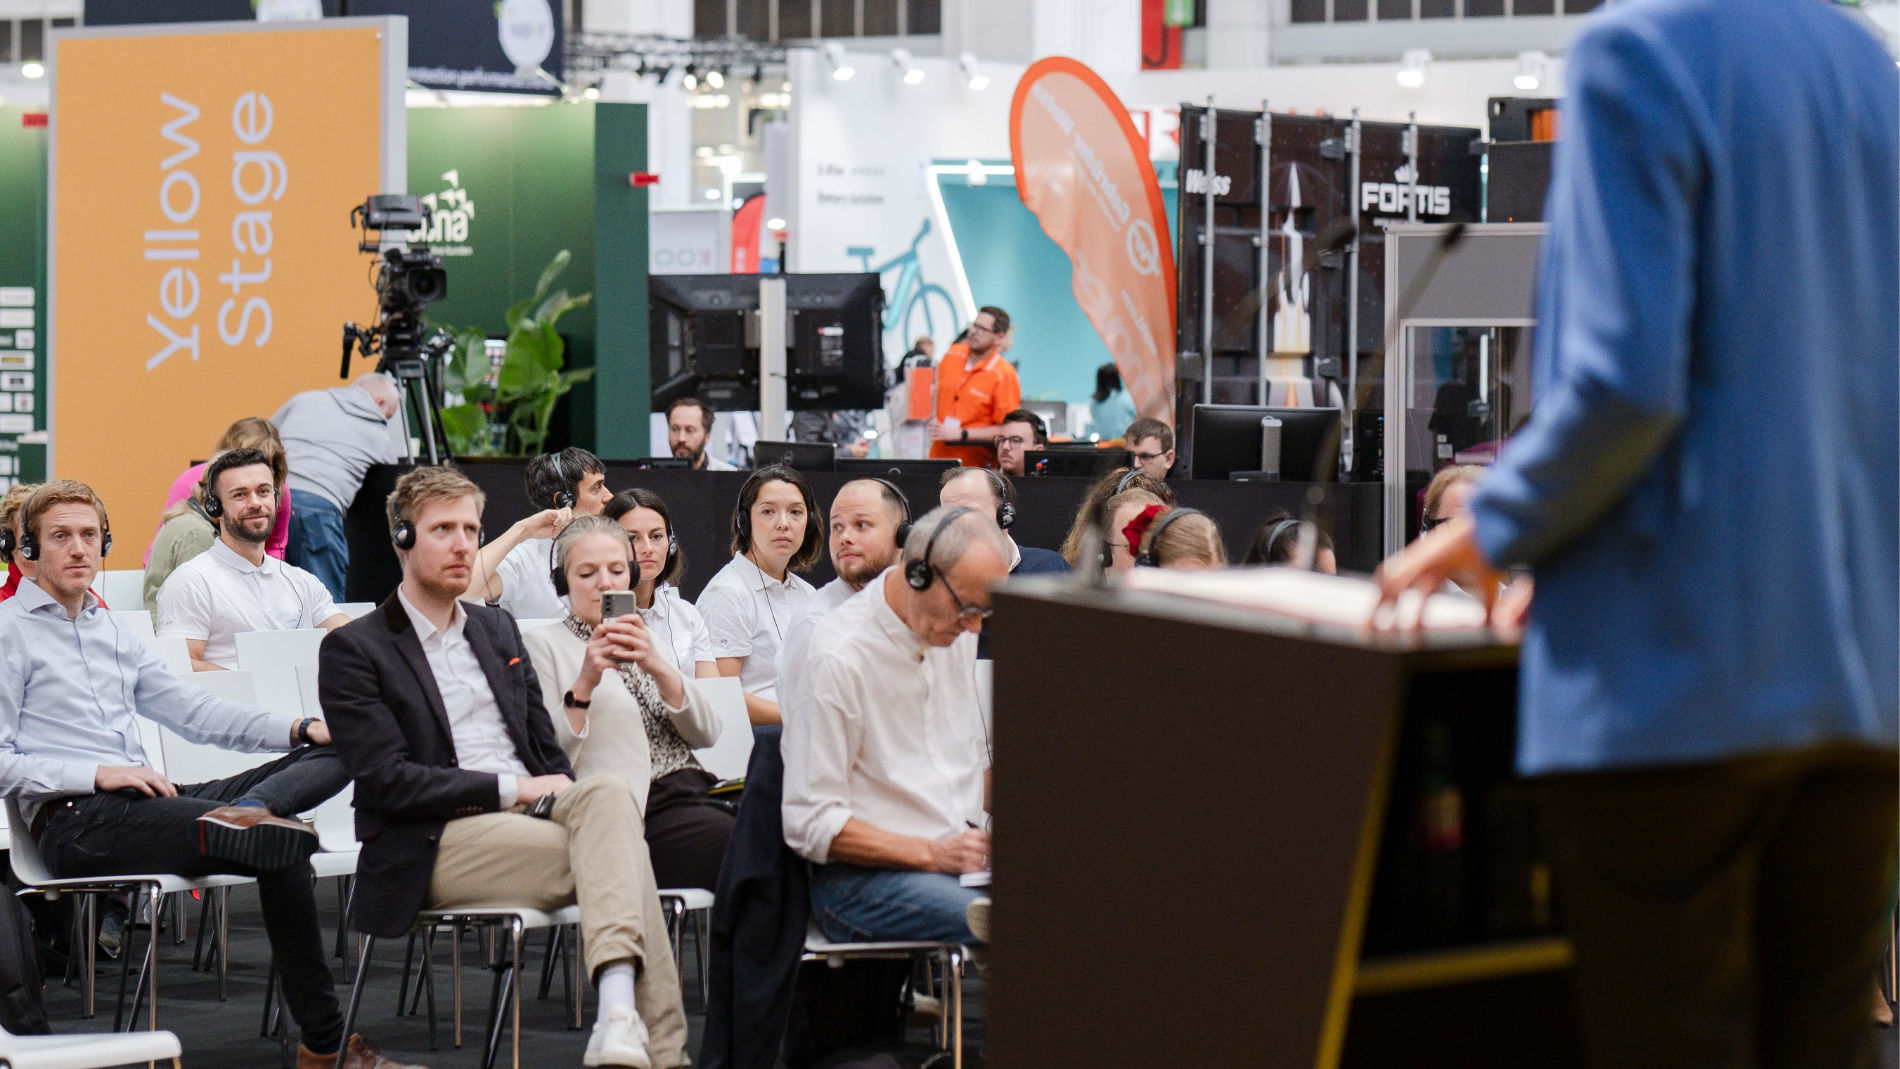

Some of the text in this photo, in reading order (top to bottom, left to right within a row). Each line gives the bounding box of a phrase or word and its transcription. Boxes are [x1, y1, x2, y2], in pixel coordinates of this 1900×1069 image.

[144, 92, 200, 371] Yellow
[218, 91, 288, 348] Stage
[1186, 169, 1231, 195] Wess
[1361, 182, 1450, 215] FORTIS
